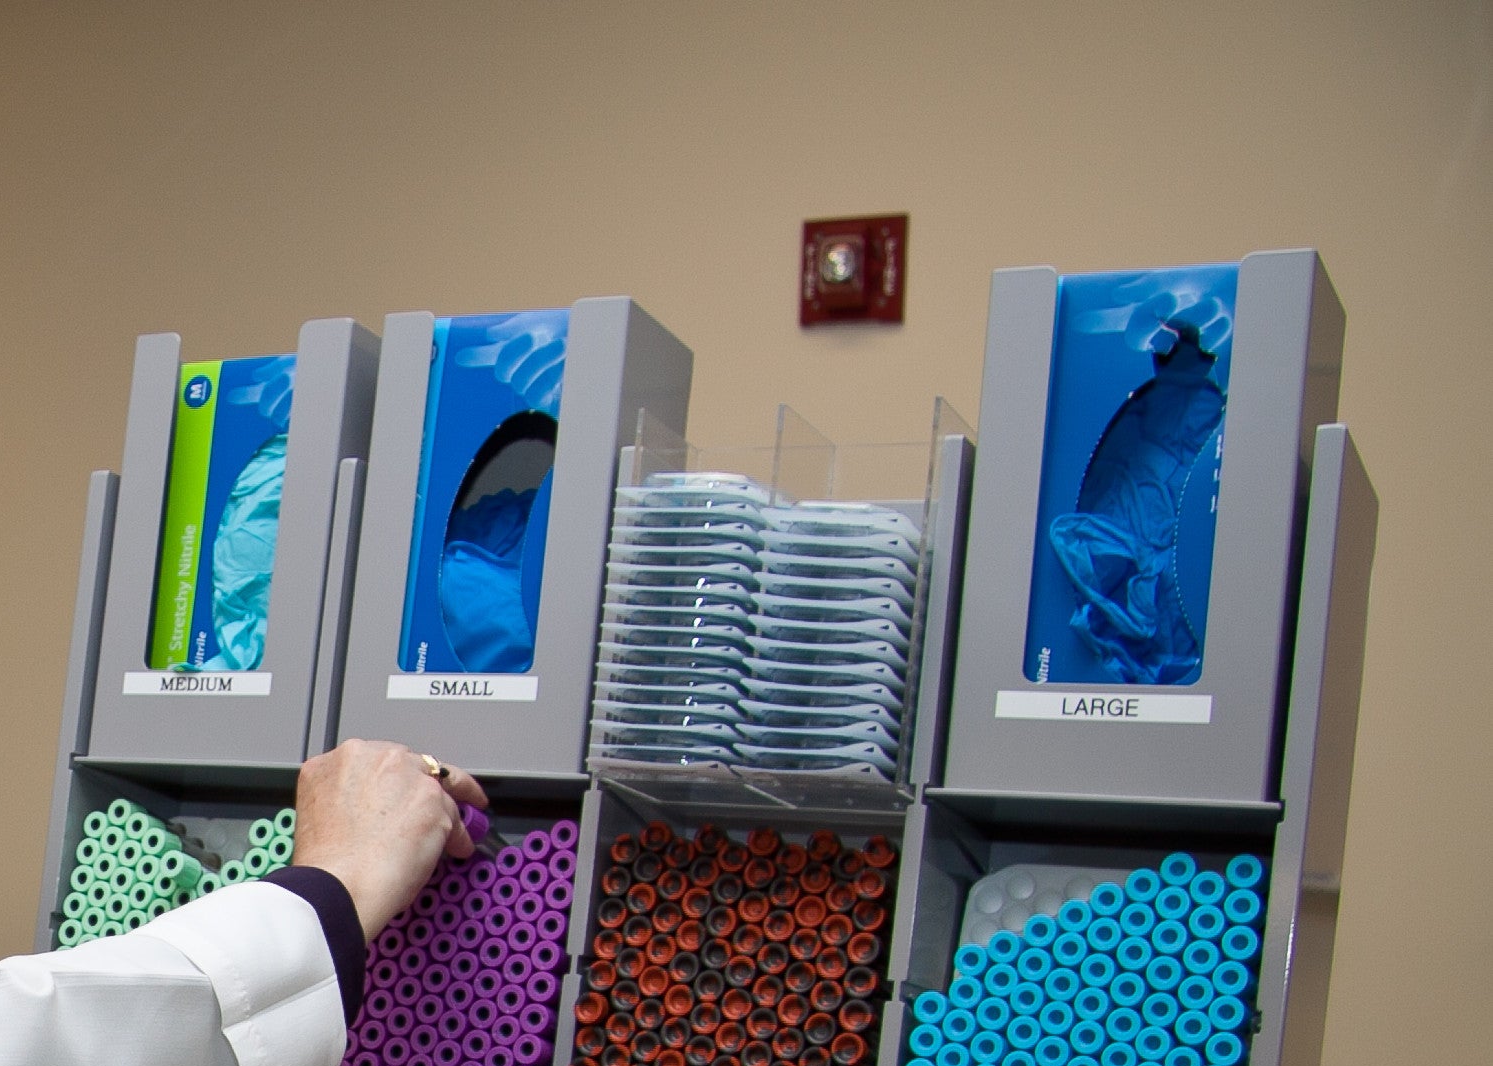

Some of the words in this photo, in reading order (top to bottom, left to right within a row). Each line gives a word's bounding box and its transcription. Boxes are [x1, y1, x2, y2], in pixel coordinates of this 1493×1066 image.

[190, 384, 202, 398] M
[178, 524, 196, 577] Nitrile
[169, 581, 192, 651] Stretchy
[160, 677, 233, 691] MEDIUM
[430, 680, 494, 696] SMALL
[1062, 697, 1140, 717] LARGE
